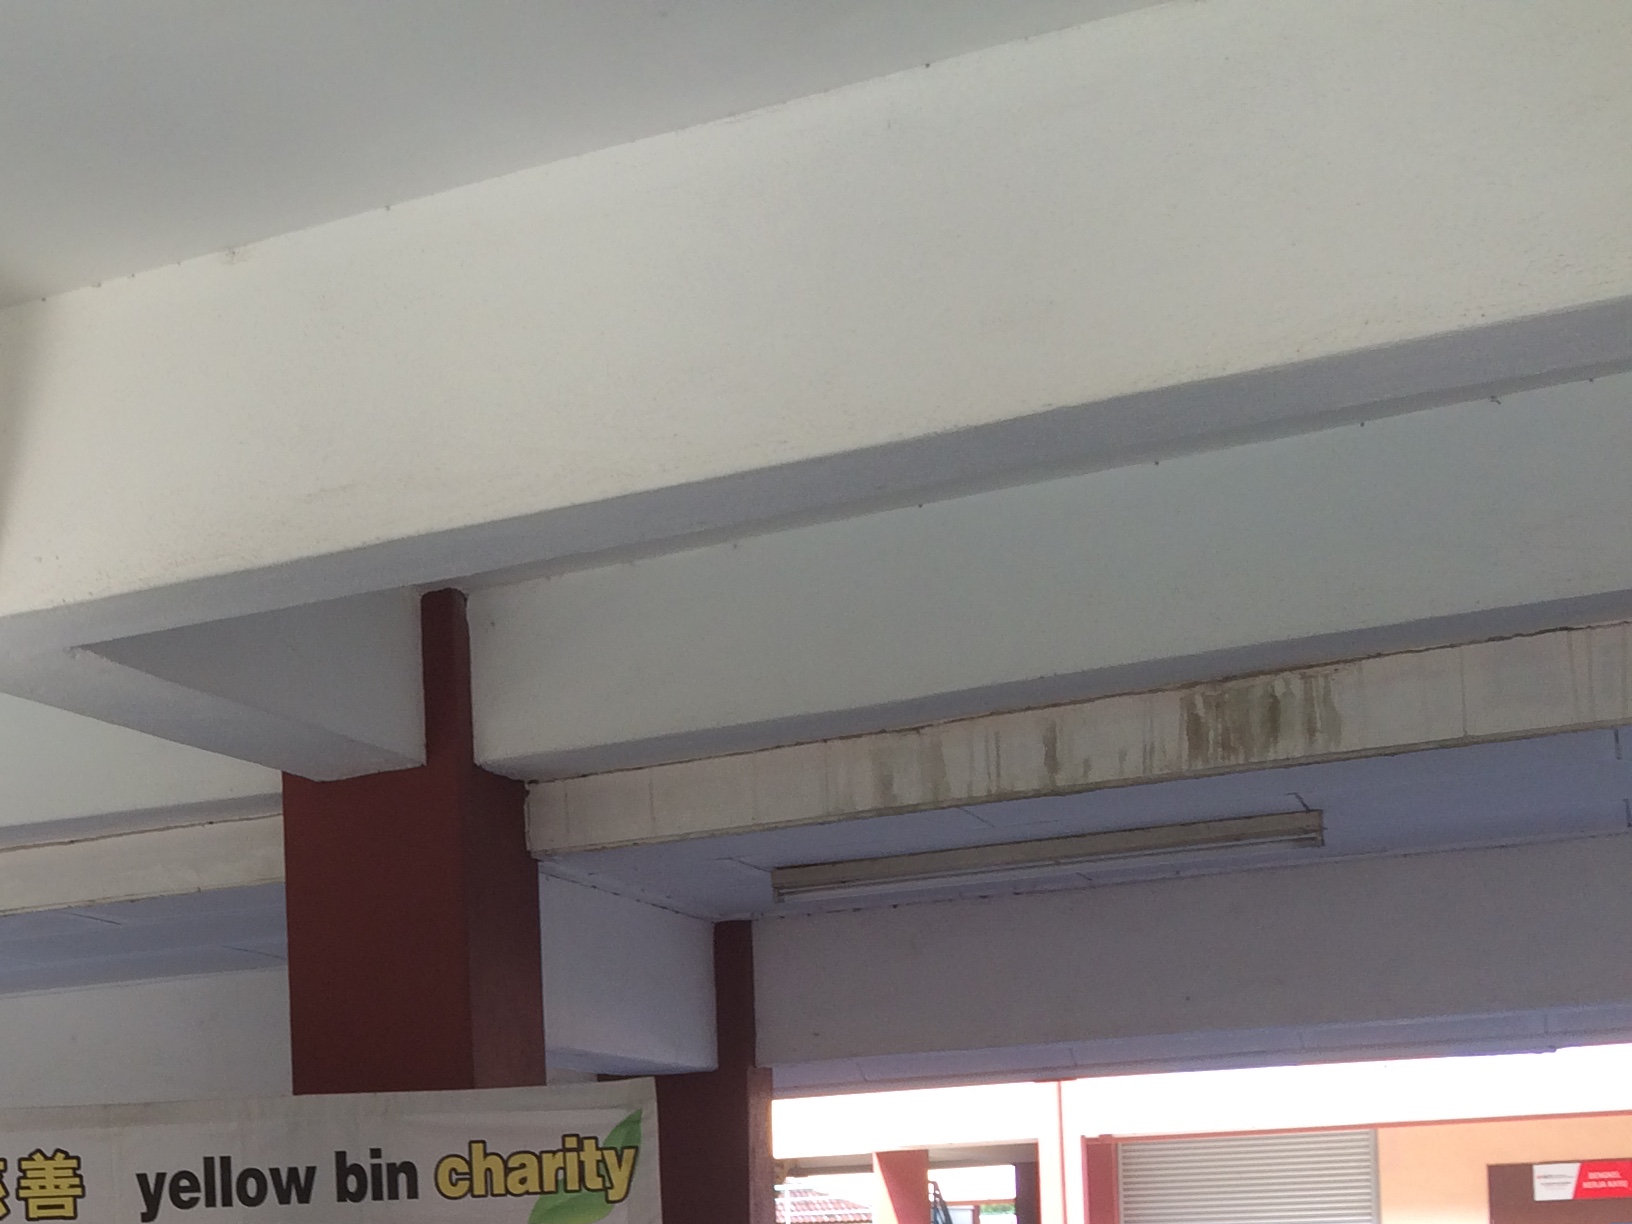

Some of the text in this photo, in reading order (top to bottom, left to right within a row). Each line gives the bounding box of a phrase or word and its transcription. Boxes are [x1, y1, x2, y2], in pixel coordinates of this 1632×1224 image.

[135, 1133, 639, 1223] yellow bin charity
